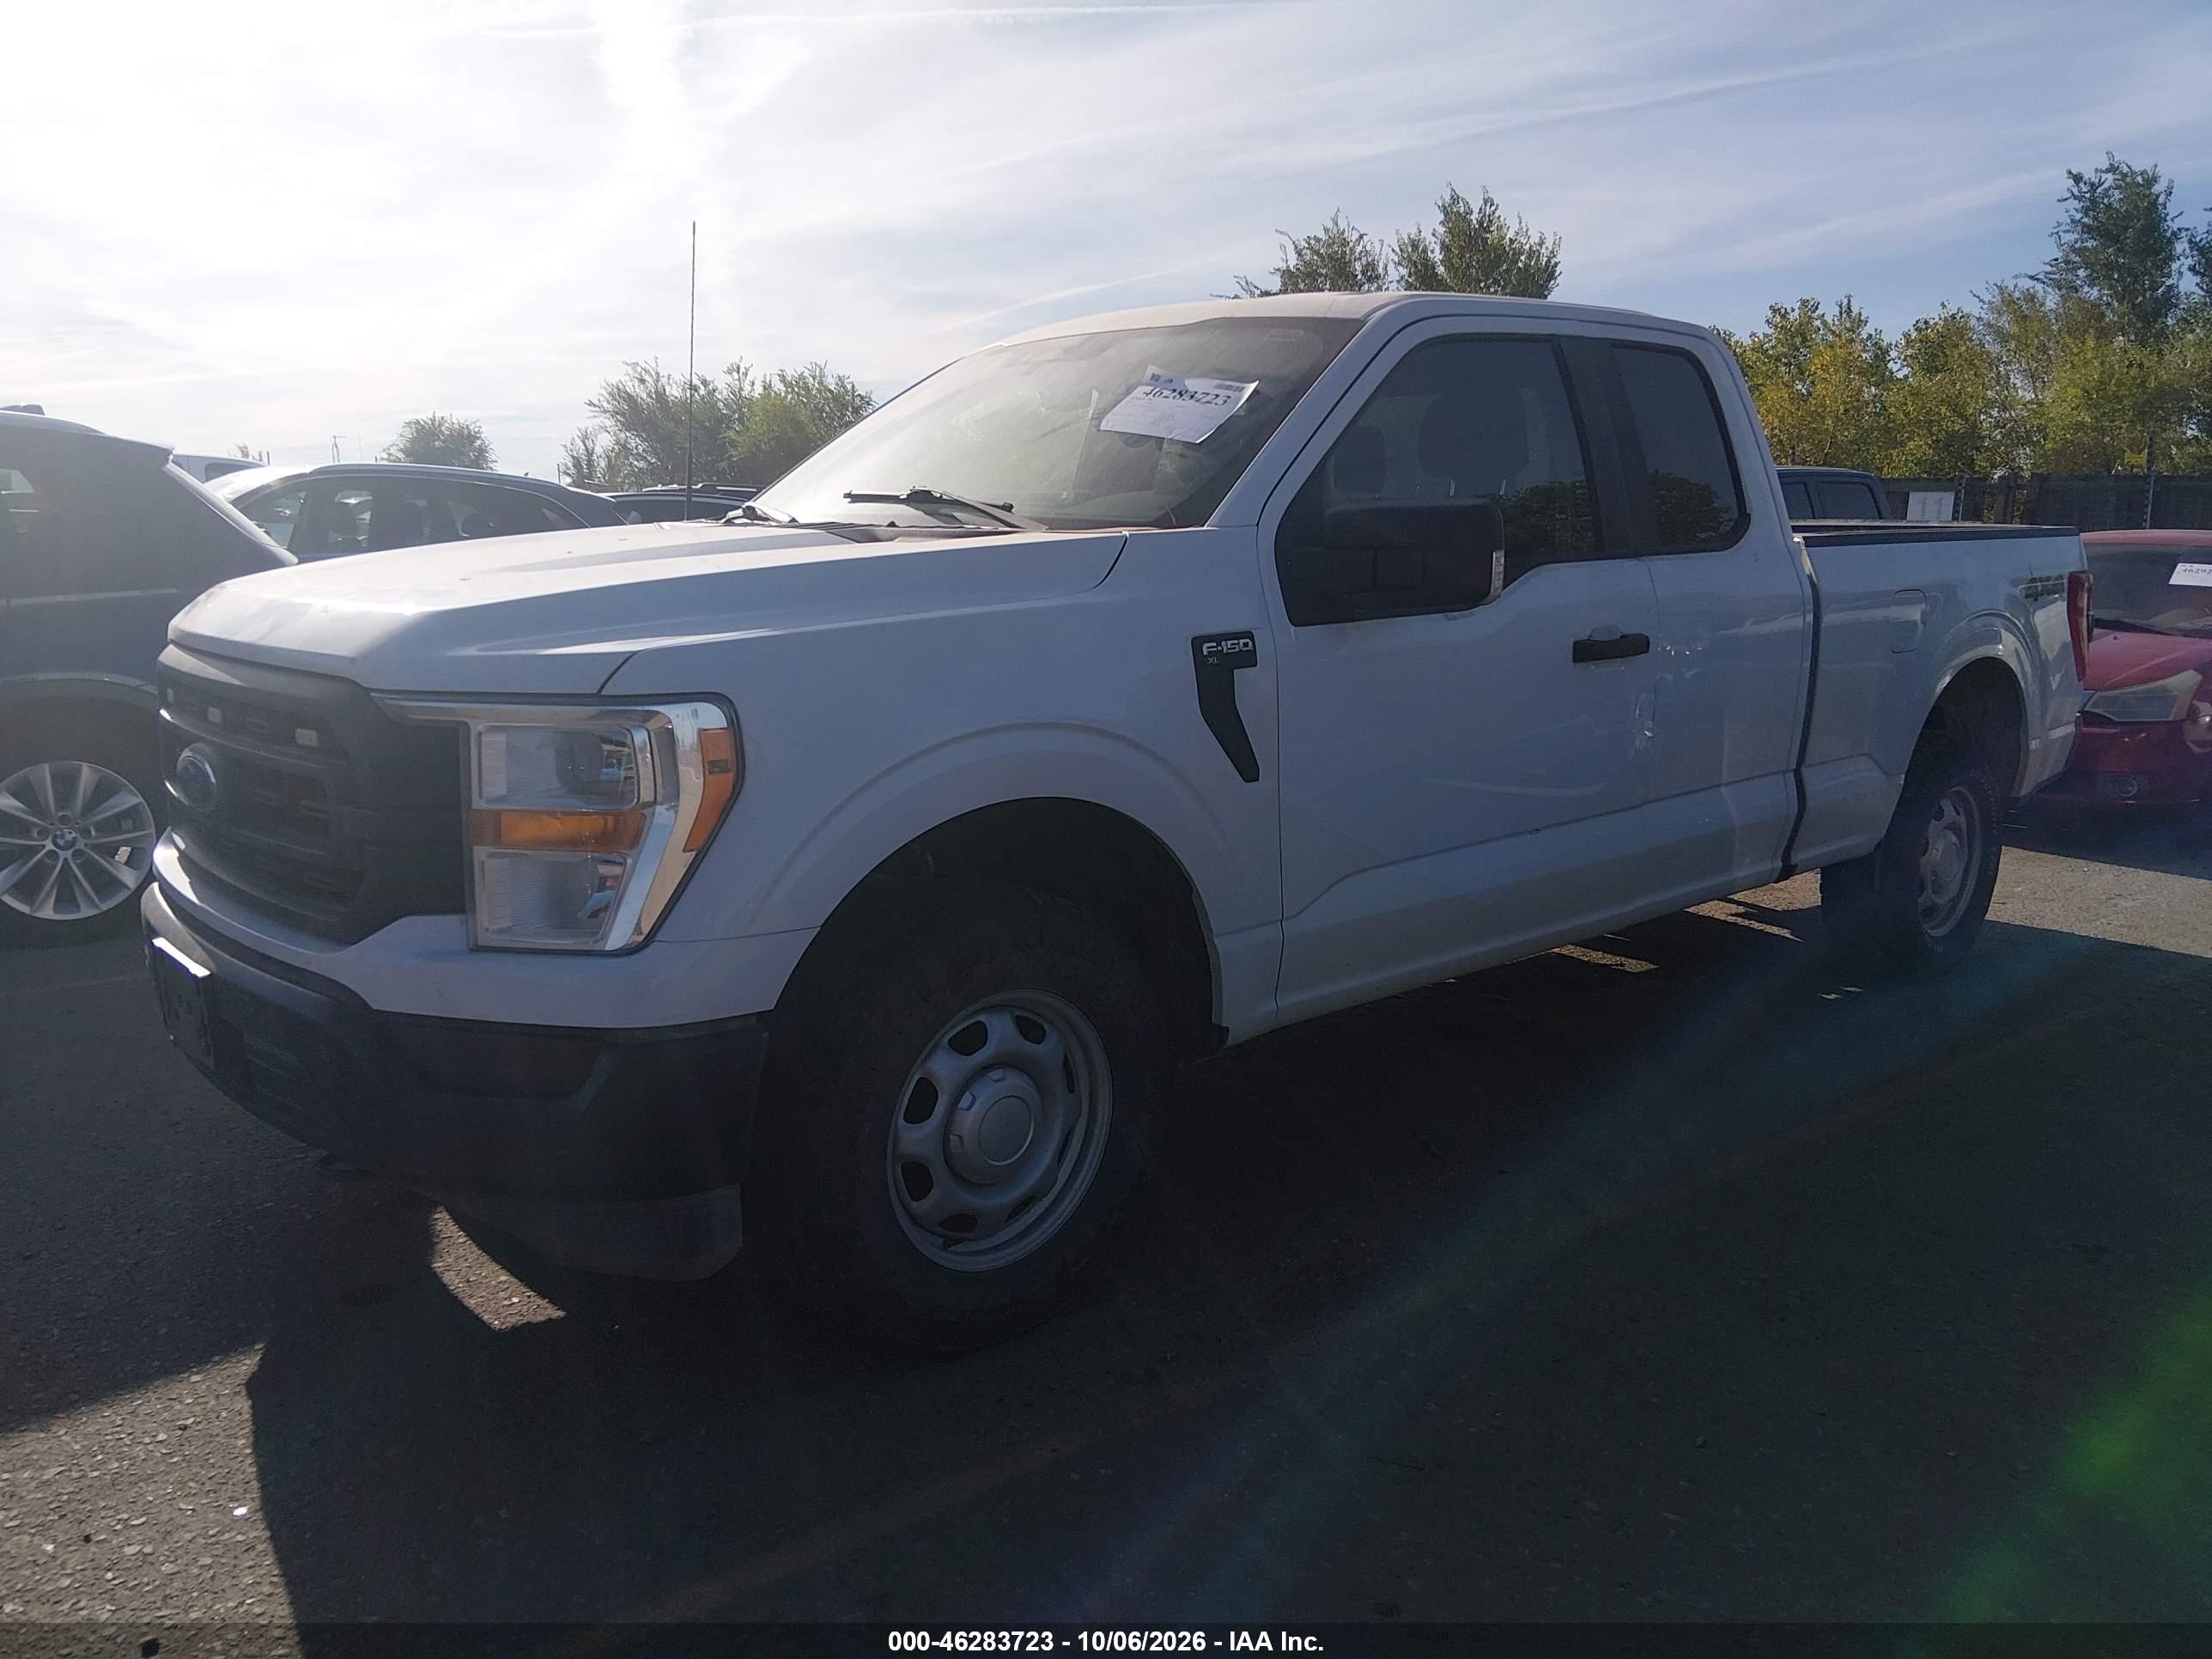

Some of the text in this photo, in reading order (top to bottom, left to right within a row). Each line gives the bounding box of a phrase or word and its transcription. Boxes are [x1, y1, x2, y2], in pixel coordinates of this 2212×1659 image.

[1142, 386, 1231, 406] 46283723
[1202, 638, 1255, 656] F-150
[1207, 656, 1220, 665] XL
